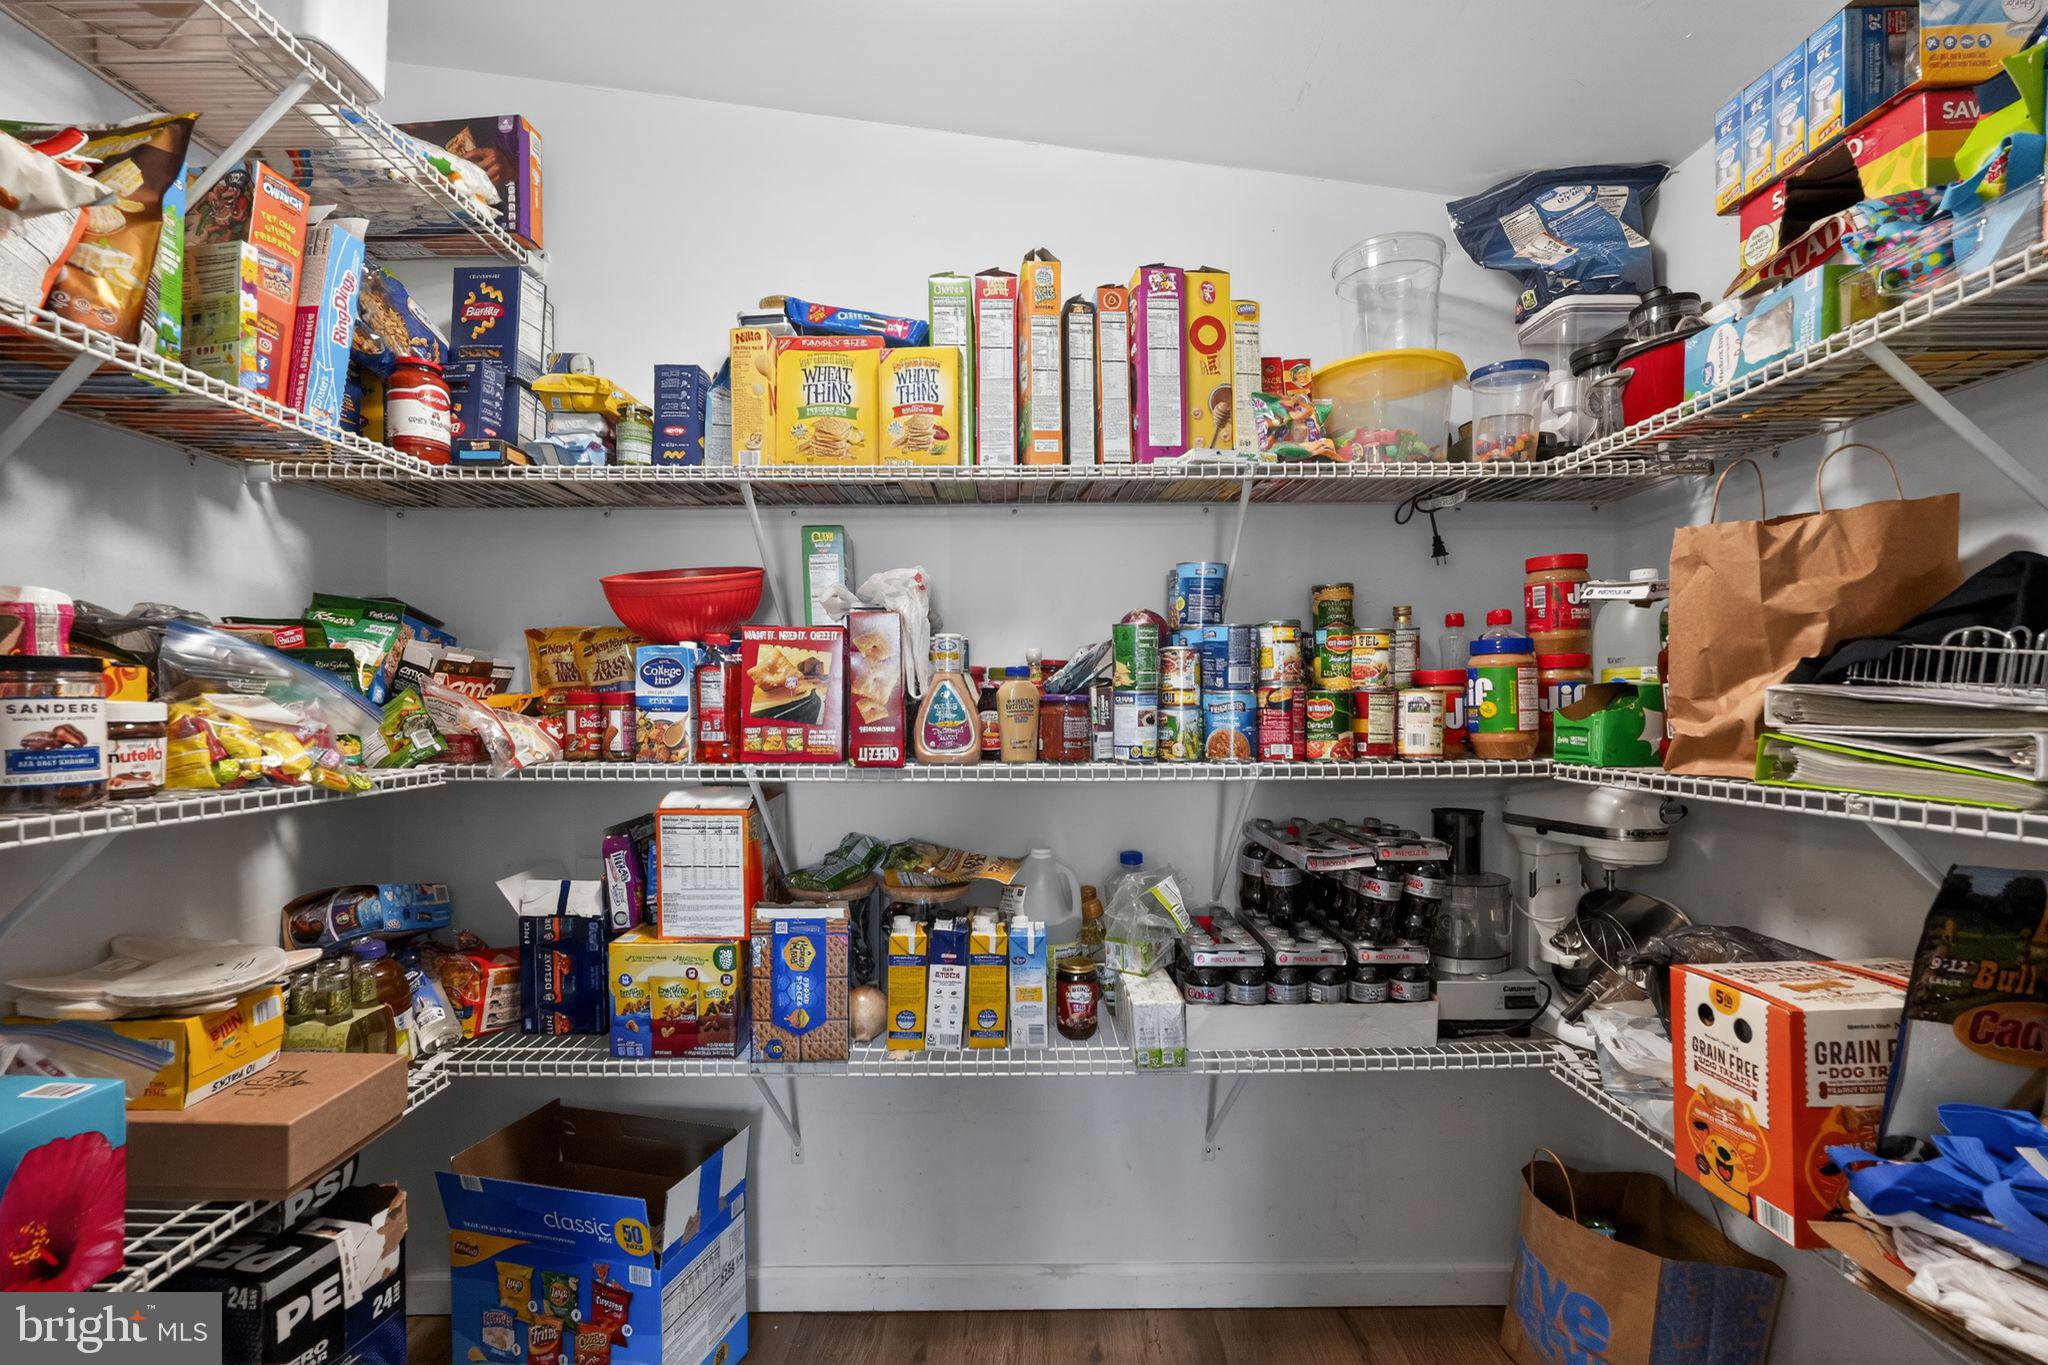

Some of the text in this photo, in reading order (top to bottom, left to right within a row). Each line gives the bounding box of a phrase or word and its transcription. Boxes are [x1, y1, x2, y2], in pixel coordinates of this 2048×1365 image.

[1943, 101, 1980, 119] SAV
[1768, 216, 1845, 279] GLAD
[801, 366, 853, 384] WHEAT
[895, 367, 939, 384] WHEAT
[643, 665, 682, 677] College
[5, 703, 98, 715] SANDERS
[108, 748, 162, 763] nutella
[1972, 959, 2038, 995] Bull
[1692, 1035, 1760, 1082] GRAIN FREE
[1814, 1039, 1881, 1065] GRAIN
[1829, 1066, 1865, 1079] DOG
[284, 1159, 354, 1231] PSI
[544, 1211, 612, 1238] classic
[622, 1225, 643, 1243] 50
[227, 1286, 248, 1310] 24
[372, 1286, 393, 1320] 24
